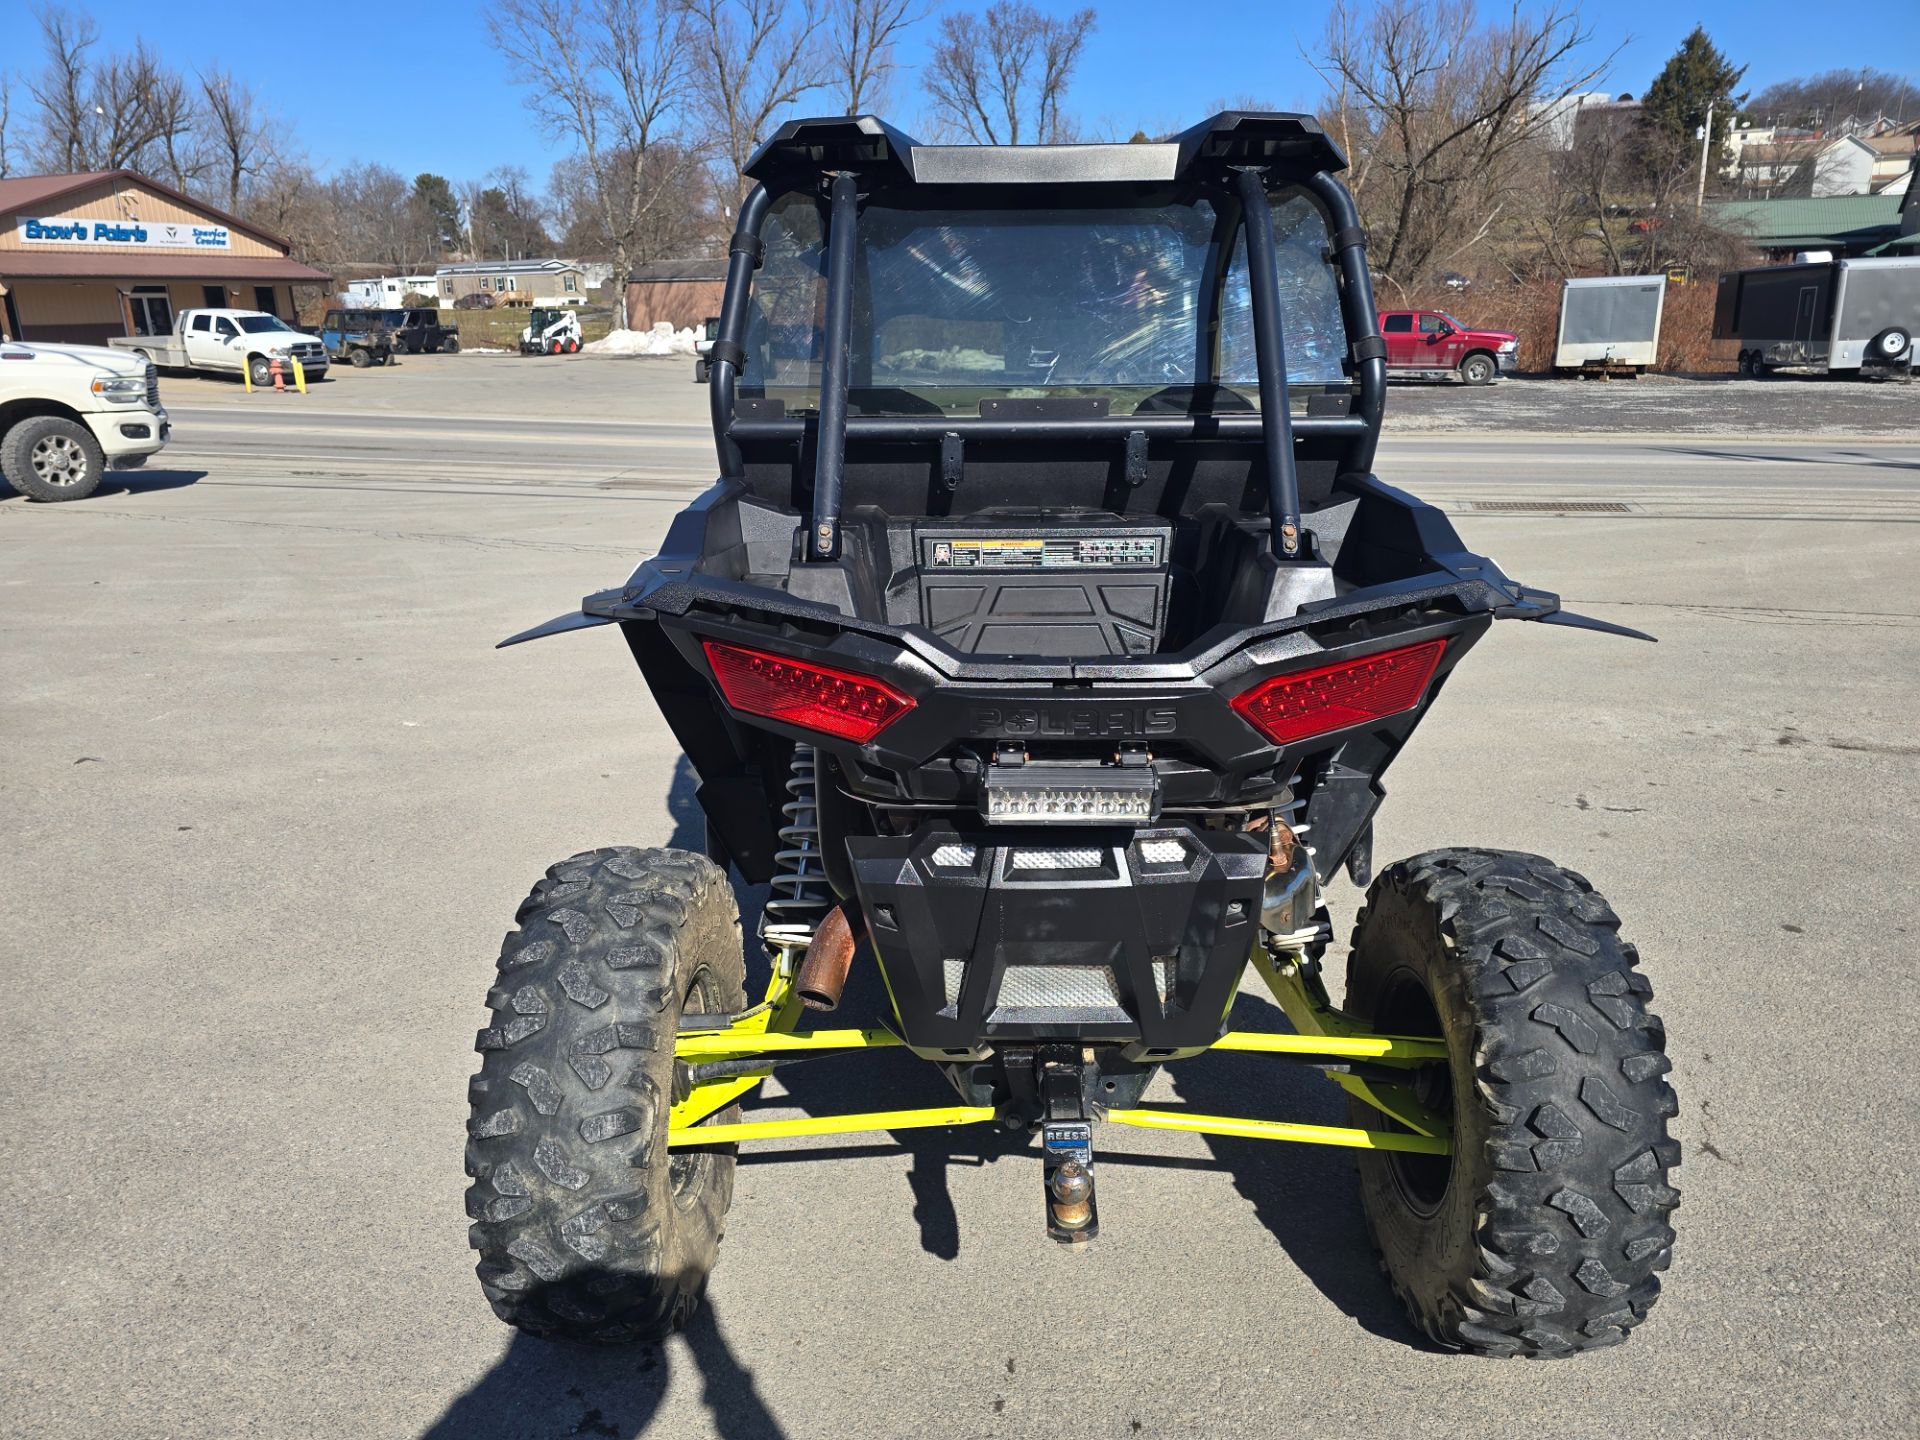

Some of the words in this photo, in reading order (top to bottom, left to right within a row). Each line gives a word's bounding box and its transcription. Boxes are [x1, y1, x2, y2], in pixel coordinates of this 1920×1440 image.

[25, 219, 88, 240] Snow's
[93, 222, 148, 242] Polaris
[969, 707, 1177, 735] POLARIS
[1047, 1131, 1088, 1140] REESE
